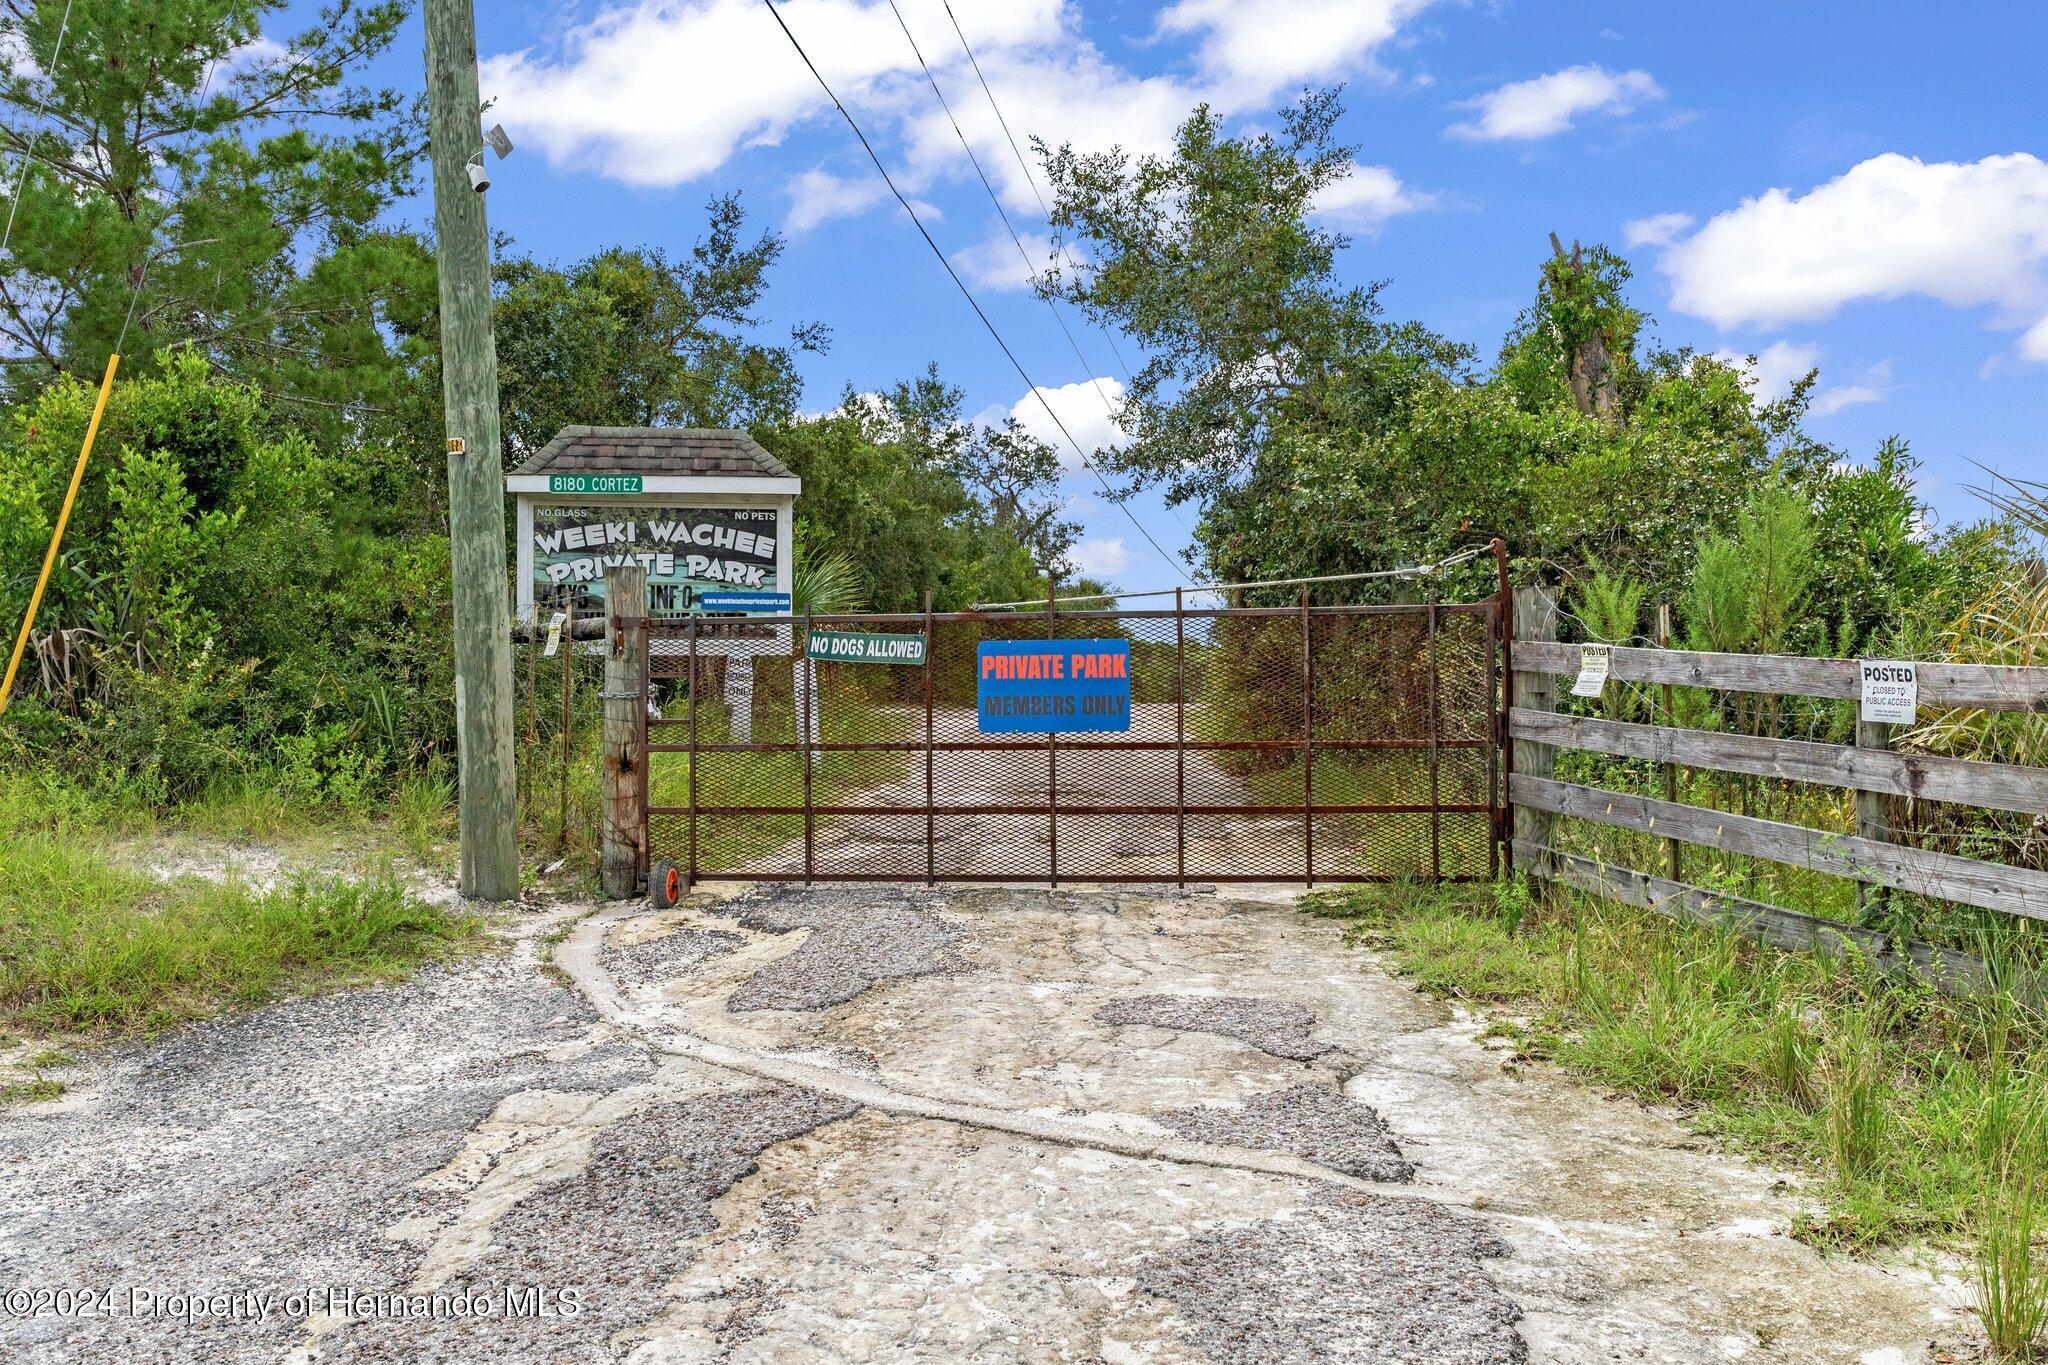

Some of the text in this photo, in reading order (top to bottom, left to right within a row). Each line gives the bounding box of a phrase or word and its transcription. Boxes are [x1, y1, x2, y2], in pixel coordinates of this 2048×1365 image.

[554, 477, 639, 492] 8180 CORTEZ
[537, 509, 587, 517] NO GLASS
[735, 512, 776, 521] NO PETS
[534, 520, 776, 559] WEEKI WACHEE
[546, 552, 765, 589] PRIVATE PARK
[811, 636, 922, 658] NO DOGS ALLOWED
[982, 653, 1127, 679] PRIVATE PARK
[1864, 667, 1912, 682] POSTED
[1873, 686, 1906, 696] CLOSED TO
[984, 694, 1125, 717] MEMBERS ONLY
[1866, 697, 1910, 706] PUBLIC ACCESS
